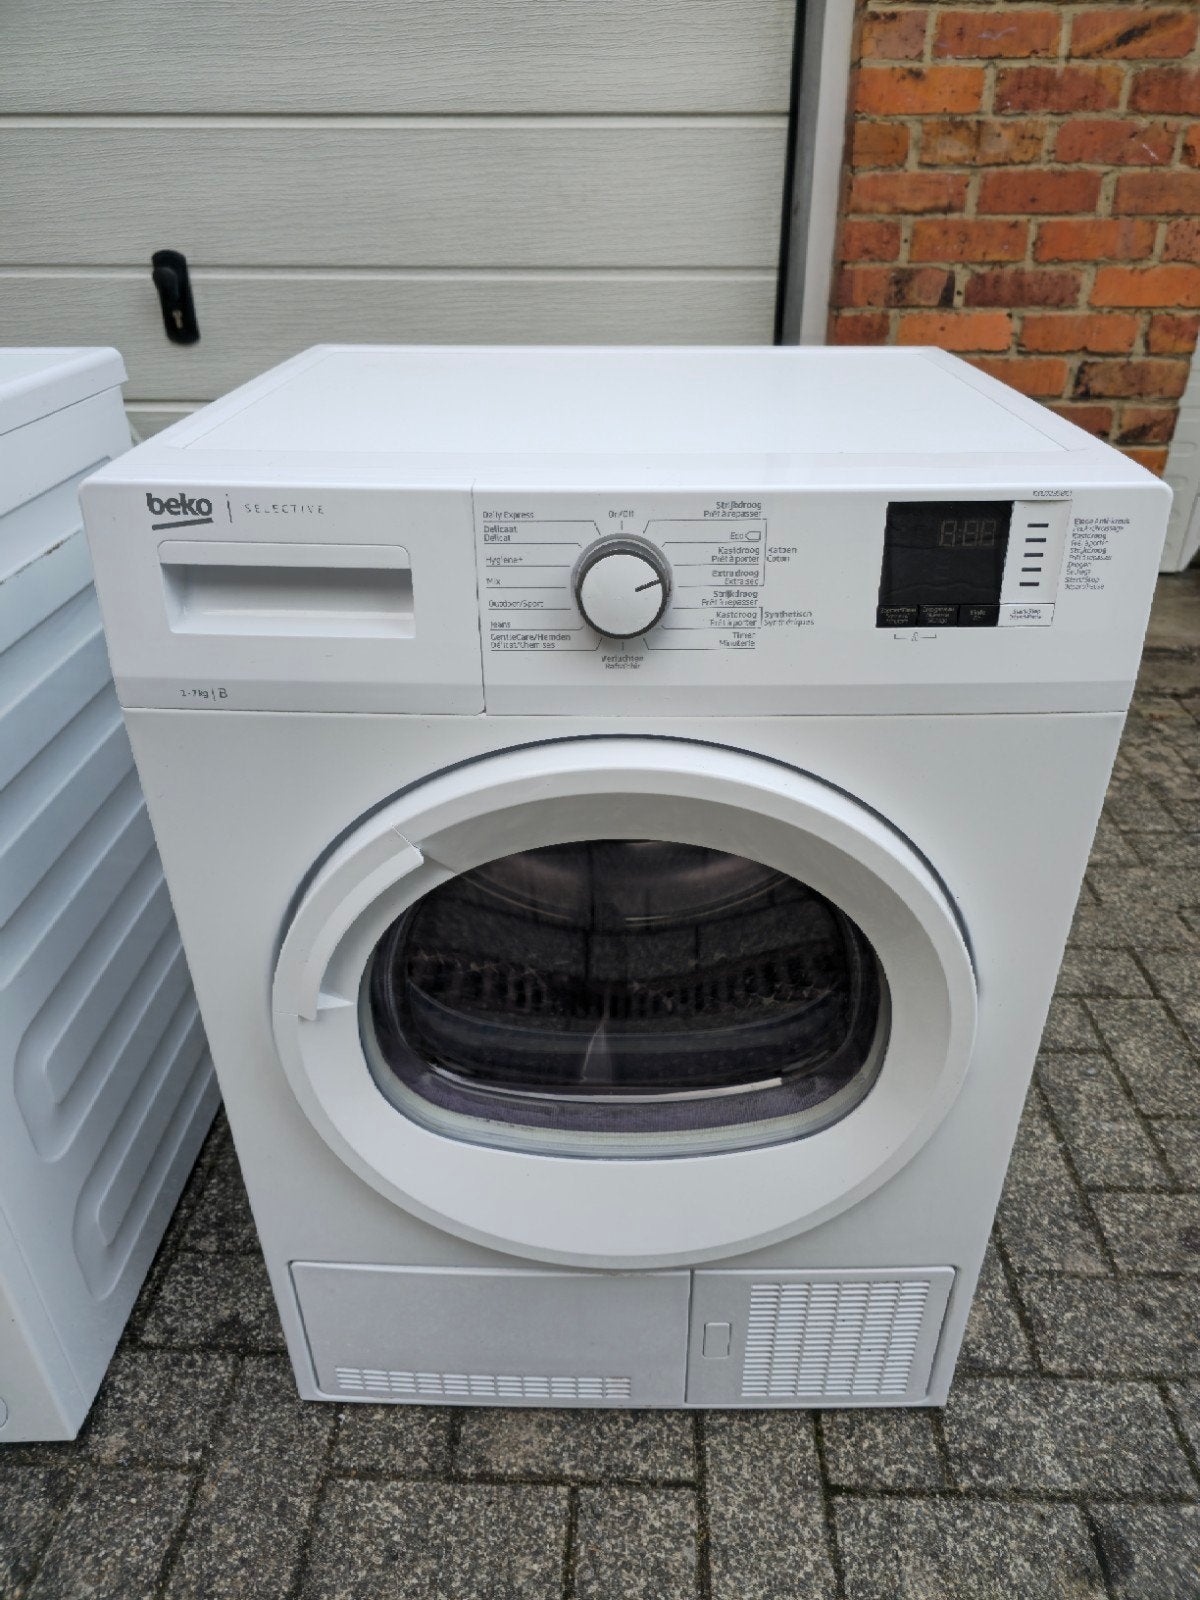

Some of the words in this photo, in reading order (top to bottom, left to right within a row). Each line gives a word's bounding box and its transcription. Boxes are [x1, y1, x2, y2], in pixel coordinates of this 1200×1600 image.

[146, 493, 213, 516] beko
[242, 504, 325, 514] SELECTIVE
[483, 511, 502, 520] Daily
[504, 511, 534, 519] Express
[608, 510, 634, 518] On/Off
[484, 525, 518, 533] Delicaat
[218, 688, 228, 698] B
